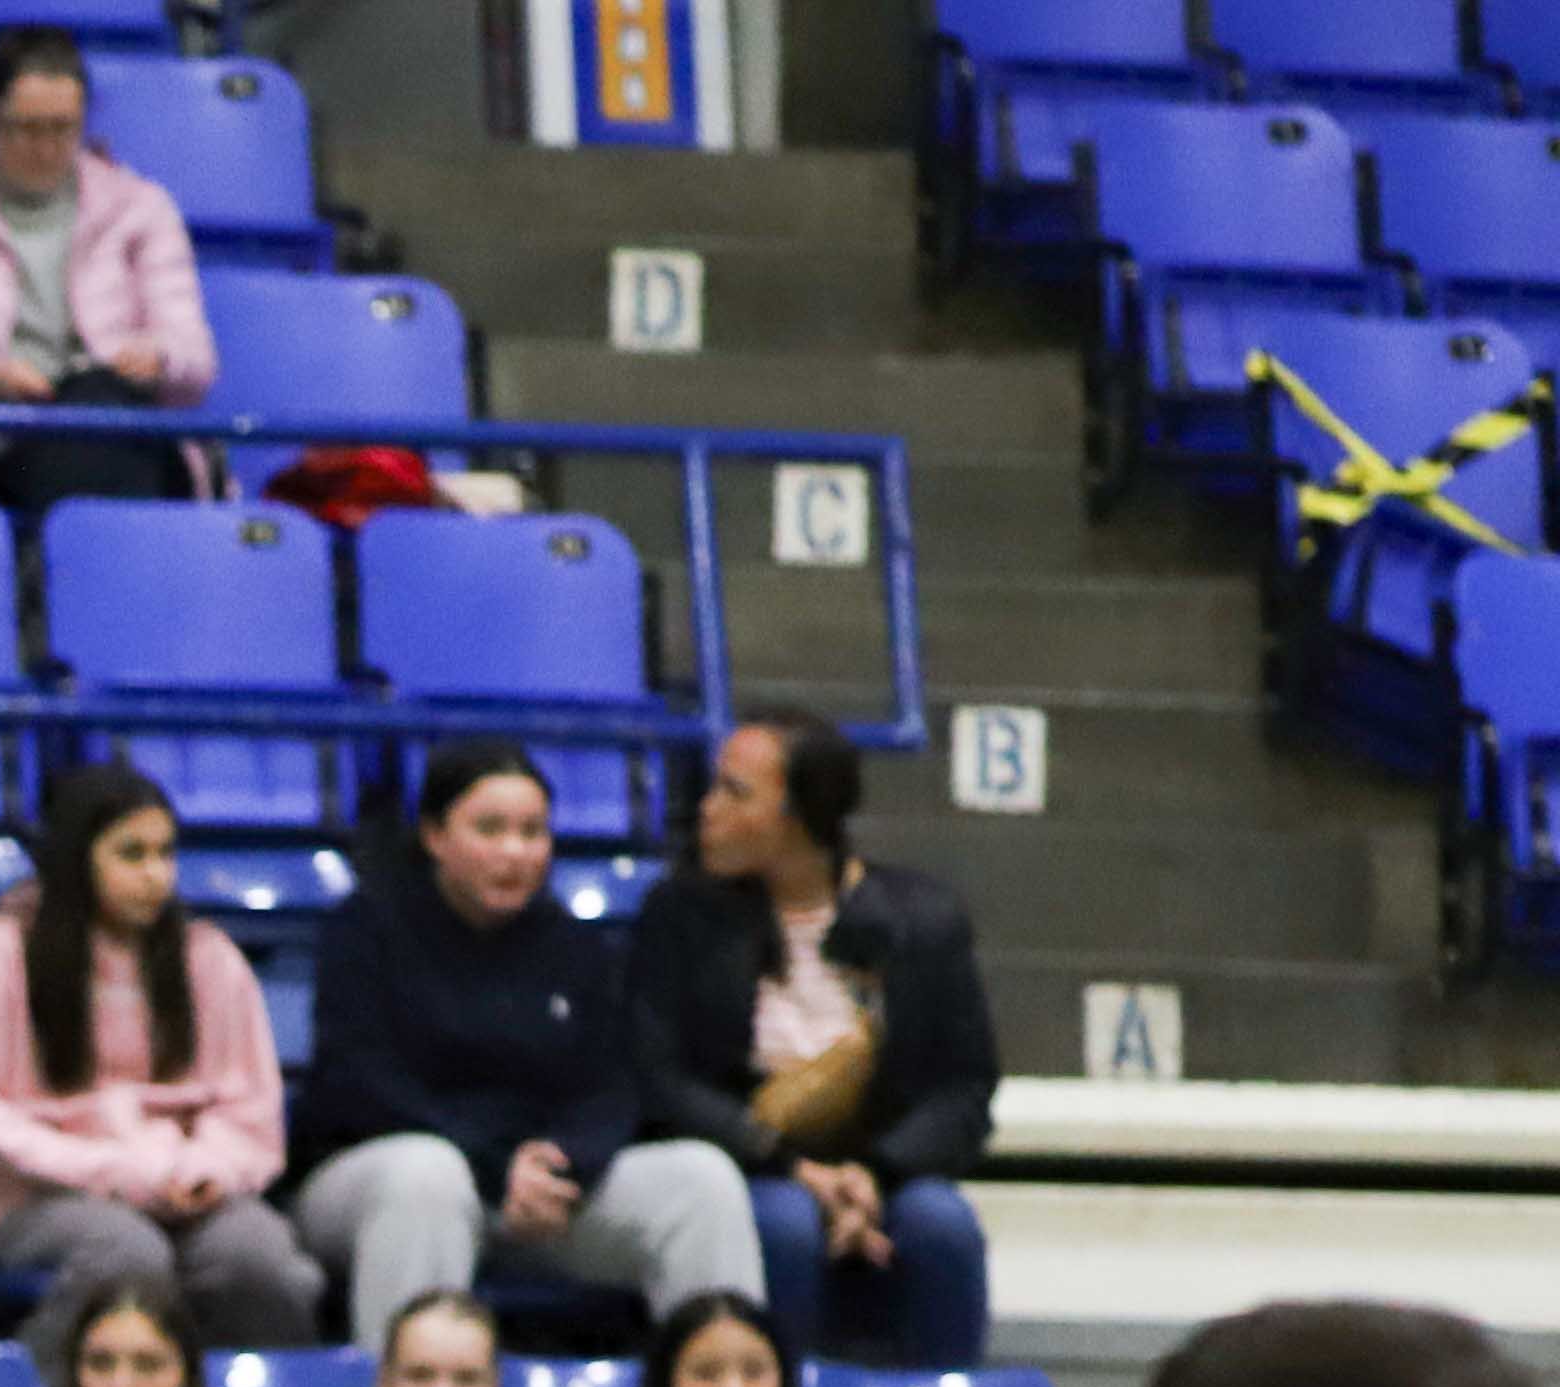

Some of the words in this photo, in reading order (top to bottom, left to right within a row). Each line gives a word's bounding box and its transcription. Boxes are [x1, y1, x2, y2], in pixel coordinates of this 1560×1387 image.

[634, 265, 683, 337] D
[801, 480, 849, 553] C
[975, 723, 1026, 792] B
[1115, 996, 1156, 1072] A
